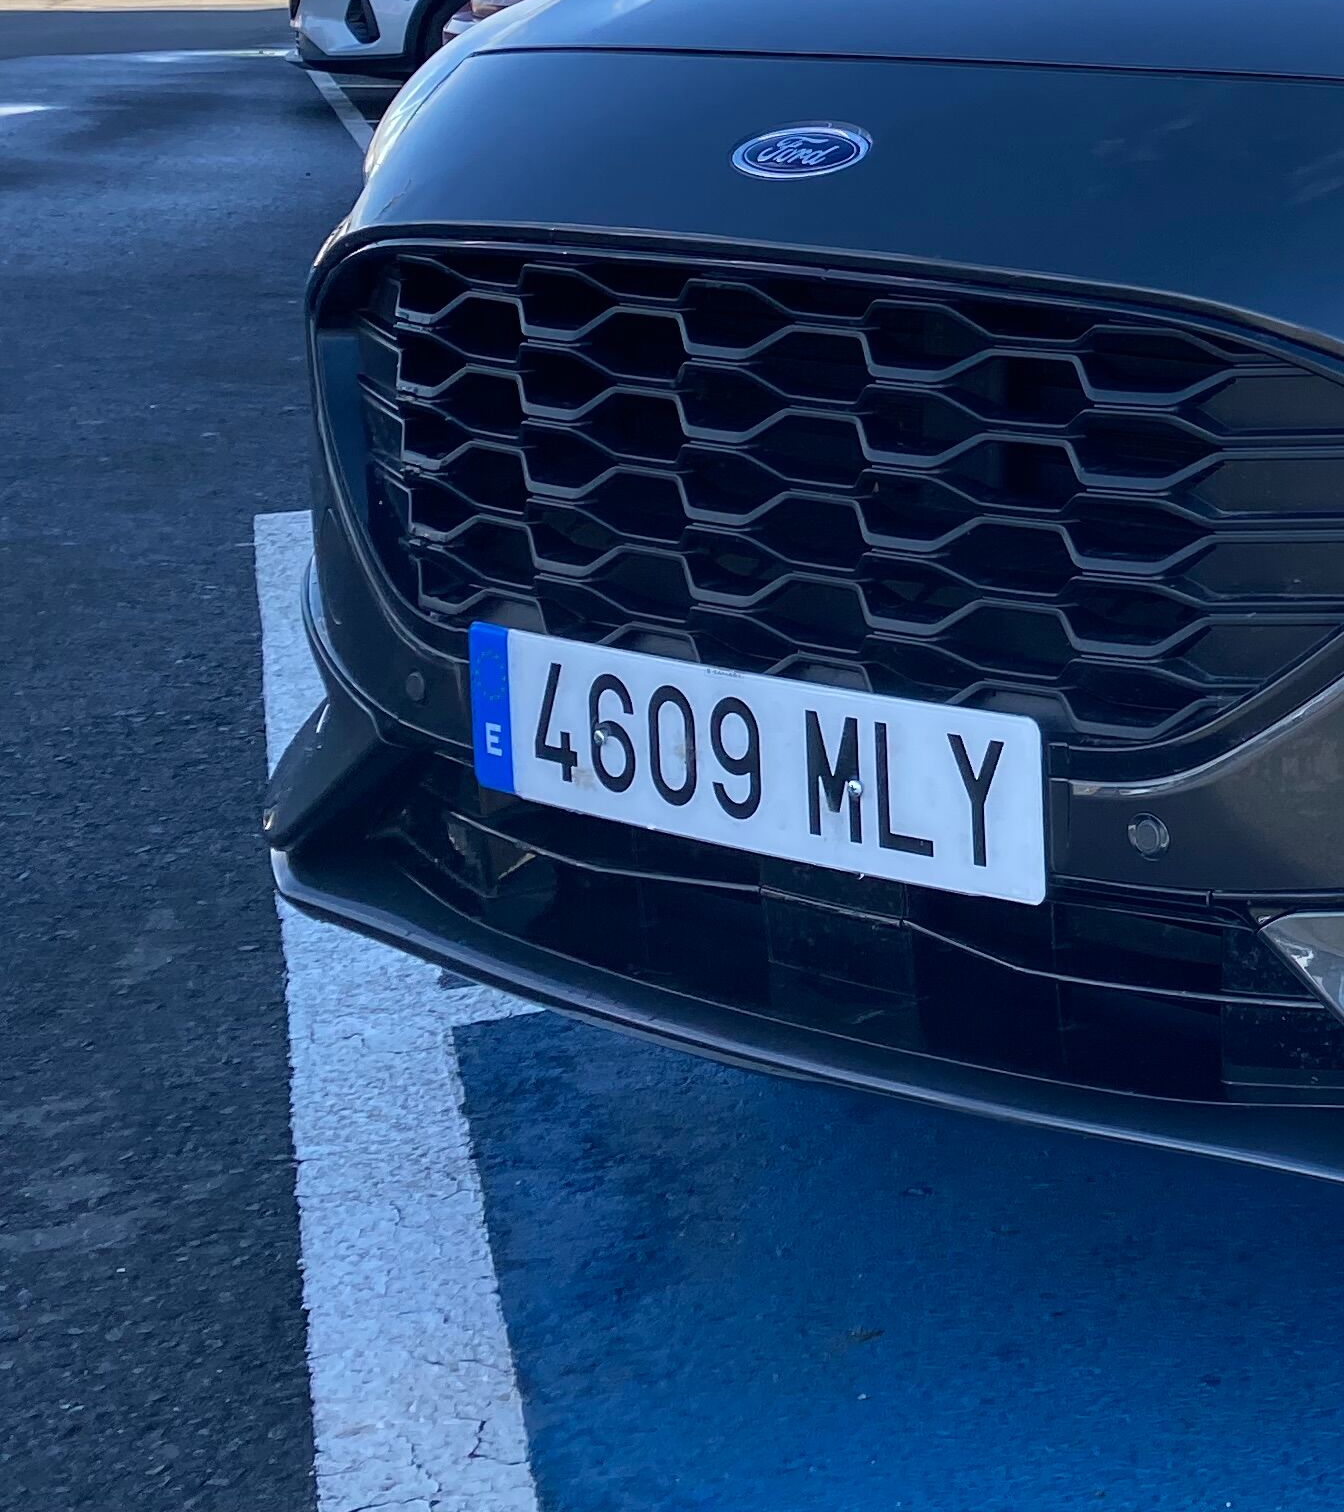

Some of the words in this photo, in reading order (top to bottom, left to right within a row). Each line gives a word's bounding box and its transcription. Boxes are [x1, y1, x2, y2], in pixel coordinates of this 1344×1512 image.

[485, 722, 503, 757] E
[535, 662, 762, 820] 4609
[805, 710, 1005, 868] MLY
